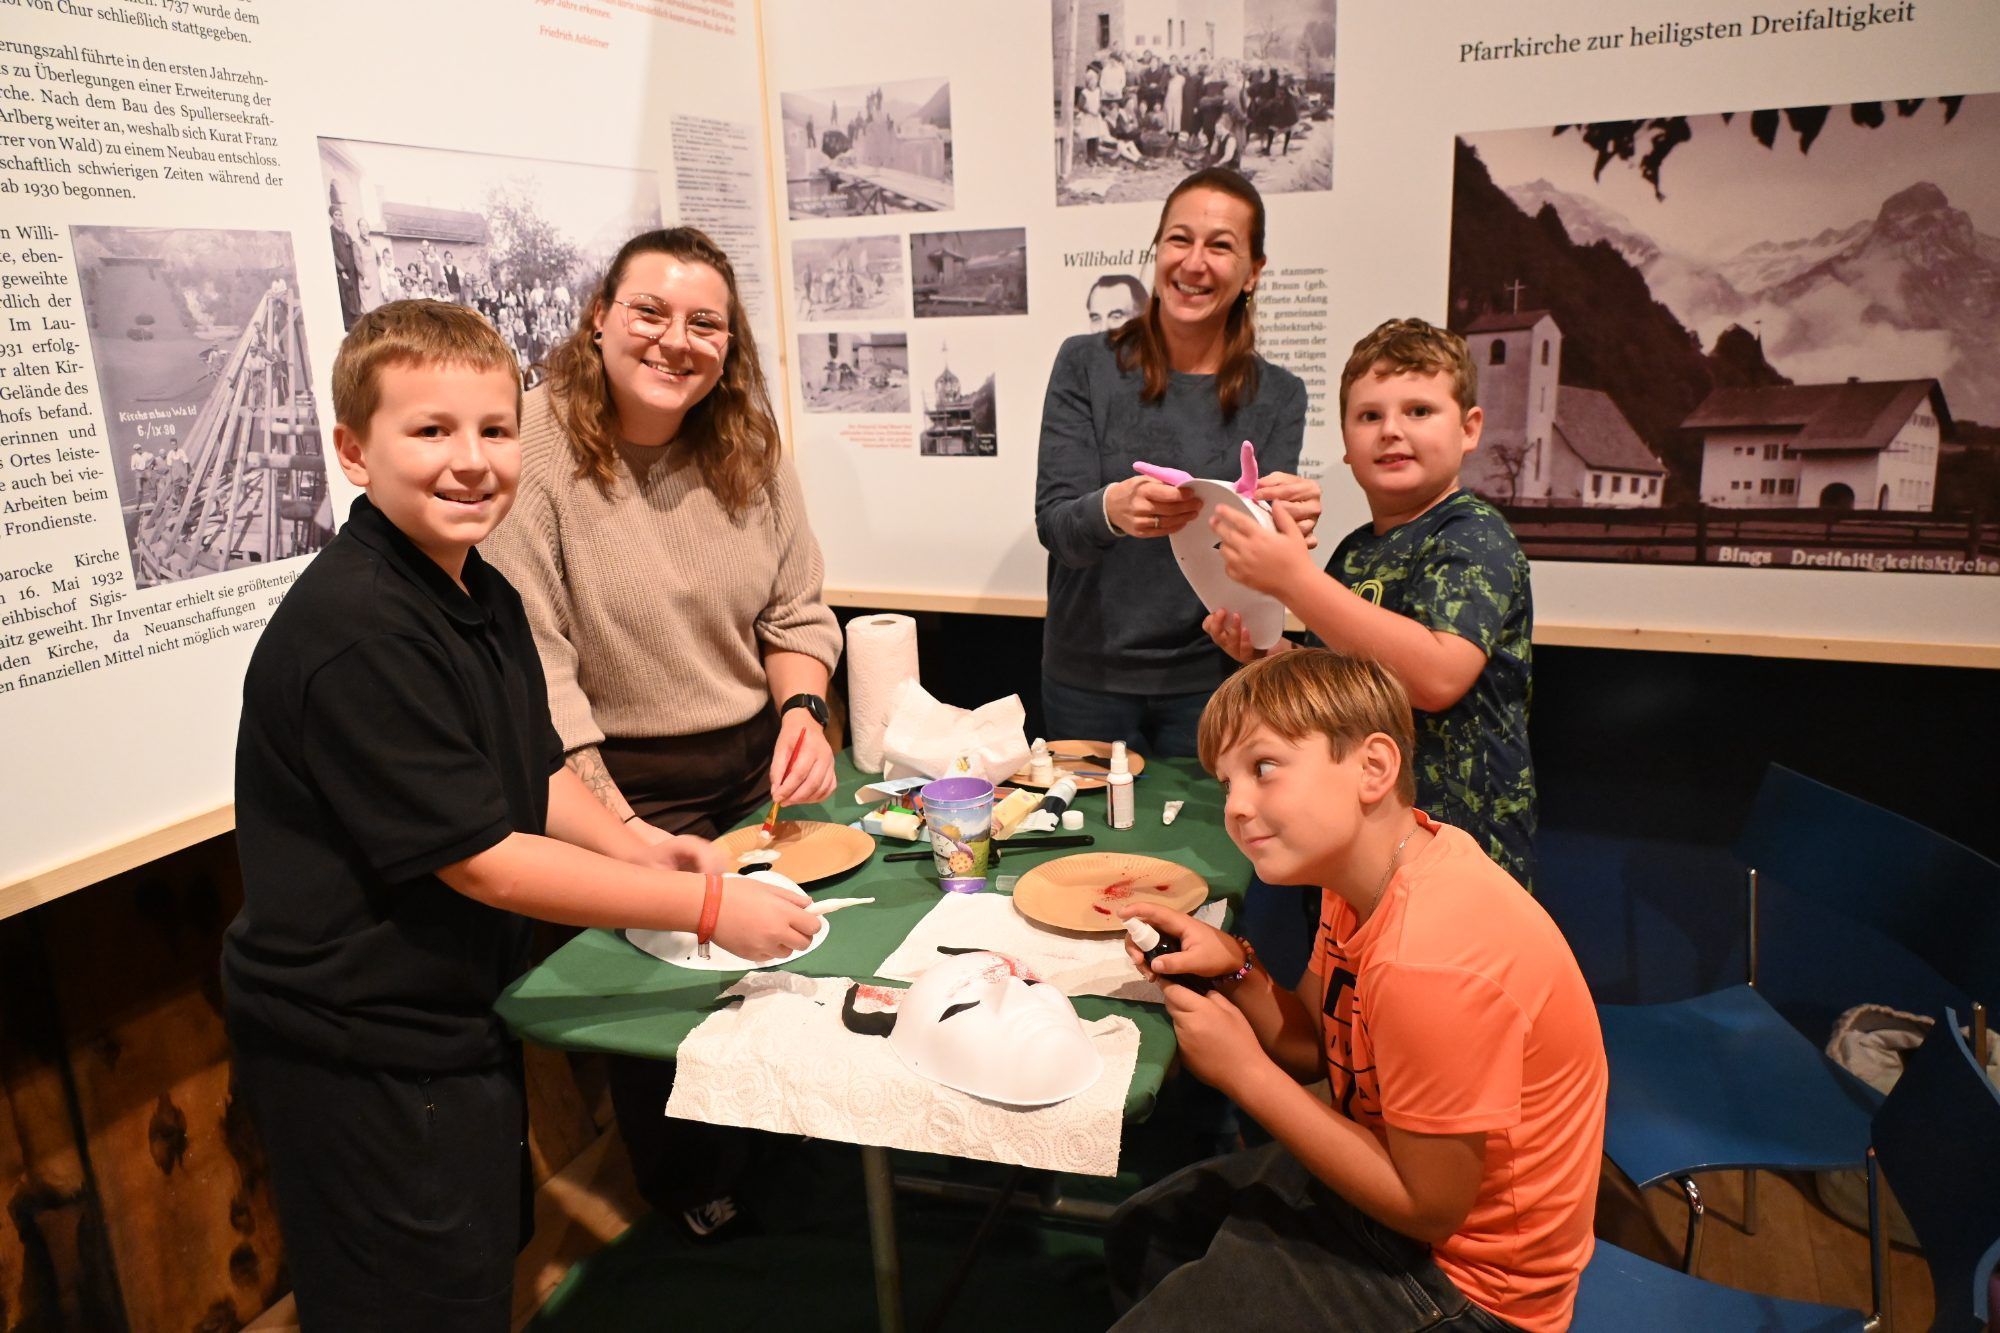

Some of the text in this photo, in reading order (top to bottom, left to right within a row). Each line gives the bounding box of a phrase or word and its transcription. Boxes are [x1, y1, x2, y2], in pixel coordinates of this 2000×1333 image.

[57, 0, 93, 17] Chur
[97, 7, 168, 29] schließlich
[171, 20, 252, 43] stattgegeben.
[161, 0, 189, 14] 1737
[193, 4, 231, 19] wurde
[234, 8, 260, 24] dem
[1459, 2, 1916, 63] Pfarrkirche zur heiligsten Dreifaltigkeit
[81, 48, 124, 67] führte
[126, 54, 140, 69] in
[143, 57, 166, 73] den
[169, 63, 207, 78] ersten
[209, 67, 268, 86] Jahrzehn-
[13, 66, 31, 78] zu
[35, 62, 135, 91] Überlegungen
[139, 79, 171, 95] einer
[175, 83, 251, 107] Erweiterung
[253, 92, 271, 106] der
[40, 88, 80, 106] Nach
[85, 94, 116, 110] dem
[123, 98, 148, 114] Bau
[153, 101, 176, 116] des
[180, 104, 275, 126] Spullerseekraft-
[0, 108, 278, 147] Arlberg weiter an, weshalb sich Kurat Franz
[0, 135, 280, 166] rer von Wald) zu einem Neubau entschloss.
[0, 155, 283, 186] schaftlich schwierigen Zeiten während der
[1, 178, 136, 199] ab 1930 begonnen.
[16, 225, 59, 240] Willi-
[22, 248, 63, 263] eben-
[1064, 251, 1133, 267] Willibald
[2, 271, 68, 289] geweihte
[1271, 281, 1300, 291] Braun
[0, 293, 72, 309] dlich der
[1294, 294, 1328, 305] Anfang
[9, 317, 76, 331] Im Lau-
[1274, 308, 1327, 319] gemeinsam
[32, 338, 80, 355] erfolg-
[13, 362, 50, 377] alten
[55, 360, 84, 374] Kir-
[0, 382, 89, 400] Gelände des
[38, 402, 93, 421] befand.
[69, 423, 97, 439] und
[10, 453, 51, 468] Ortes
[57, 447, 100, 462] leiste-
[12, 473, 47, 490] auch
[51, 469, 74, 485] bei
[78, 467, 104, 481] vie-
[3, 488, 109, 514] Arbeiten beim
[4, 512, 97, 536] Frondienste.
[74, 549, 120, 568] Kirche
[1718, 546, 1999, 574] Bings Dreifaltigkeitskirche
[19, 585, 40, 600] 16.
[52, 576, 80, 593] Mai
[91, 570, 124, 587] 1932
[90, 590, 128, 607] Sigis-
[28, 619, 88, 646] geweiht.
[91, 613, 114, 628] Ihr
[117, 599, 172, 622] Inventar
[175, 589, 215, 609] erhielt
[218, 585, 234, 599] sie
[46, 637, 98, 660] Kirche,
[113, 629, 130, 643] da
[144, 601, 256, 636] Neuanschaffungen
[17, 659, 101, 688] finanziellen
[104, 644, 145, 667] Mittel
[147, 639, 180, 656] nicht
[183, 624, 230, 645] möglich
